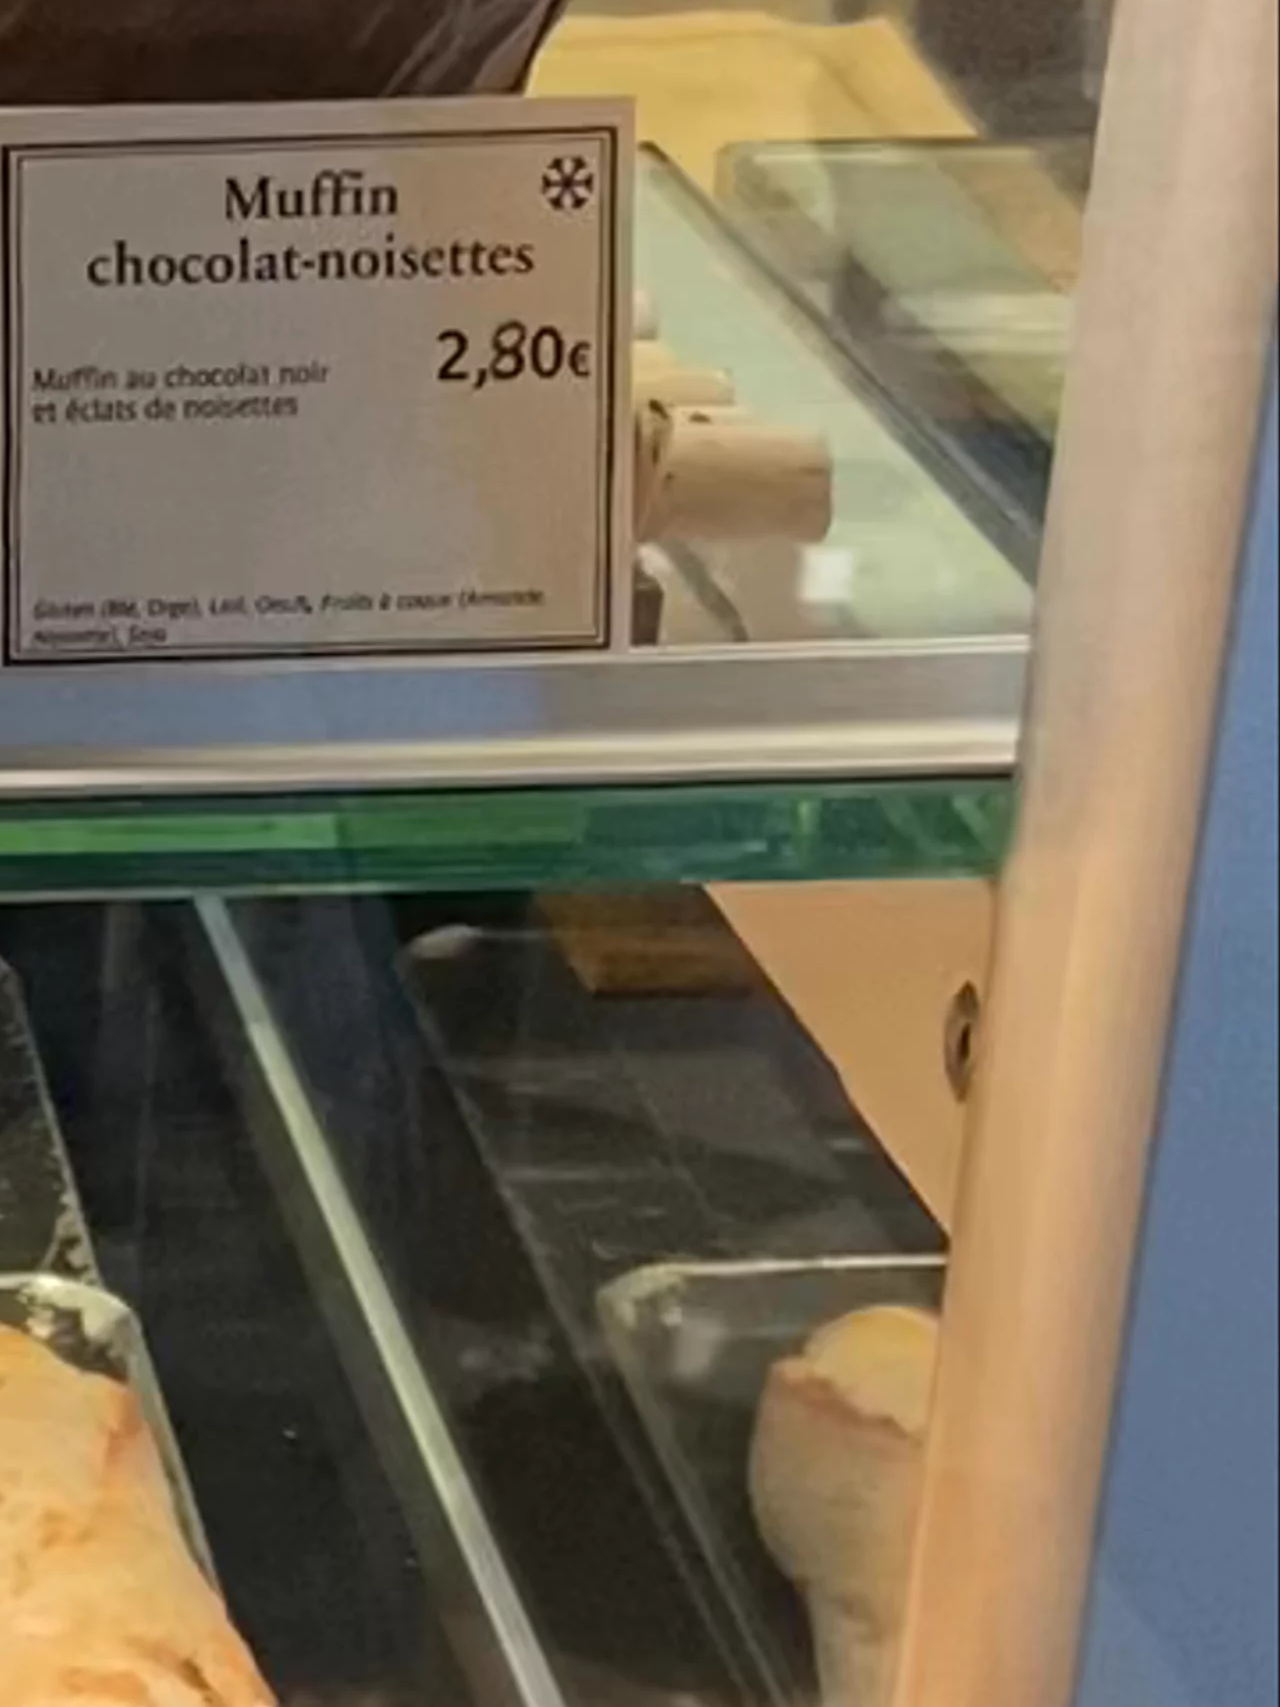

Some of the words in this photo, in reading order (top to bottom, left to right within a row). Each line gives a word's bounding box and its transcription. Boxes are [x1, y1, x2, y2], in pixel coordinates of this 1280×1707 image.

[224, 169, 399, 223] Muffin
[86, 235, 535, 287] chocolat-noisettes
[32, 364, 119, 391] Muffin
[126, 368, 157, 391] au
[165, 362, 271, 388] chocolat
[280, 360, 330, 385] noir
[436, 319, 592, 390] 2,80€
[32, 399, 57, 424] et
[65, 396, 137, 423] éclats
[143, 396, 177, 422] de
[182, 394, 298, 420] noisettes
